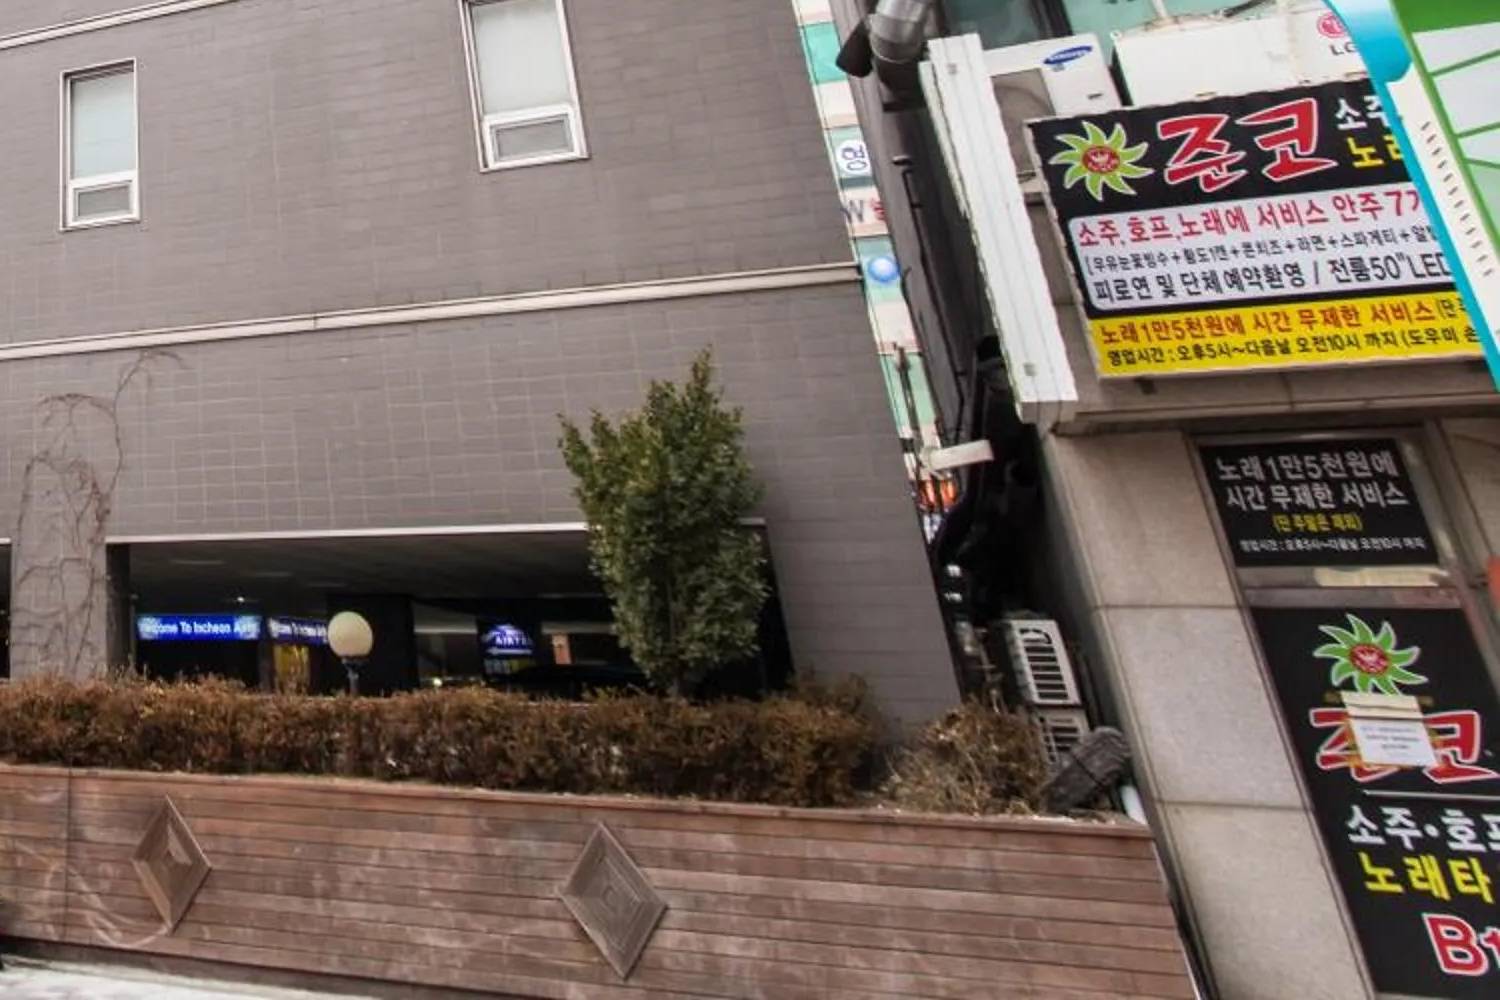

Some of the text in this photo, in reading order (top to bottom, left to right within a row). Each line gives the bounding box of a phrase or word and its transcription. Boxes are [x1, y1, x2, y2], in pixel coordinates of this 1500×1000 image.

[1156, 97, 1339, 193] 준코
[1257, 198, 1329, 231] 서비스
[1156, 273, 1176, 299] 및
[1100, 313, 1246, 344] 노래1만5천원에
[1252, 310, 1292, 334] 시간
[1298, 304, 1361, 330] 무제한
[1369, 300, 1436, 326] 서비스
[1216, 450, 1399, 483] 노래1만5천원에
[1227, 480, 1409, 512] 시간 무제한 서비스
[1360, 851, 1496, 904] 노래타
